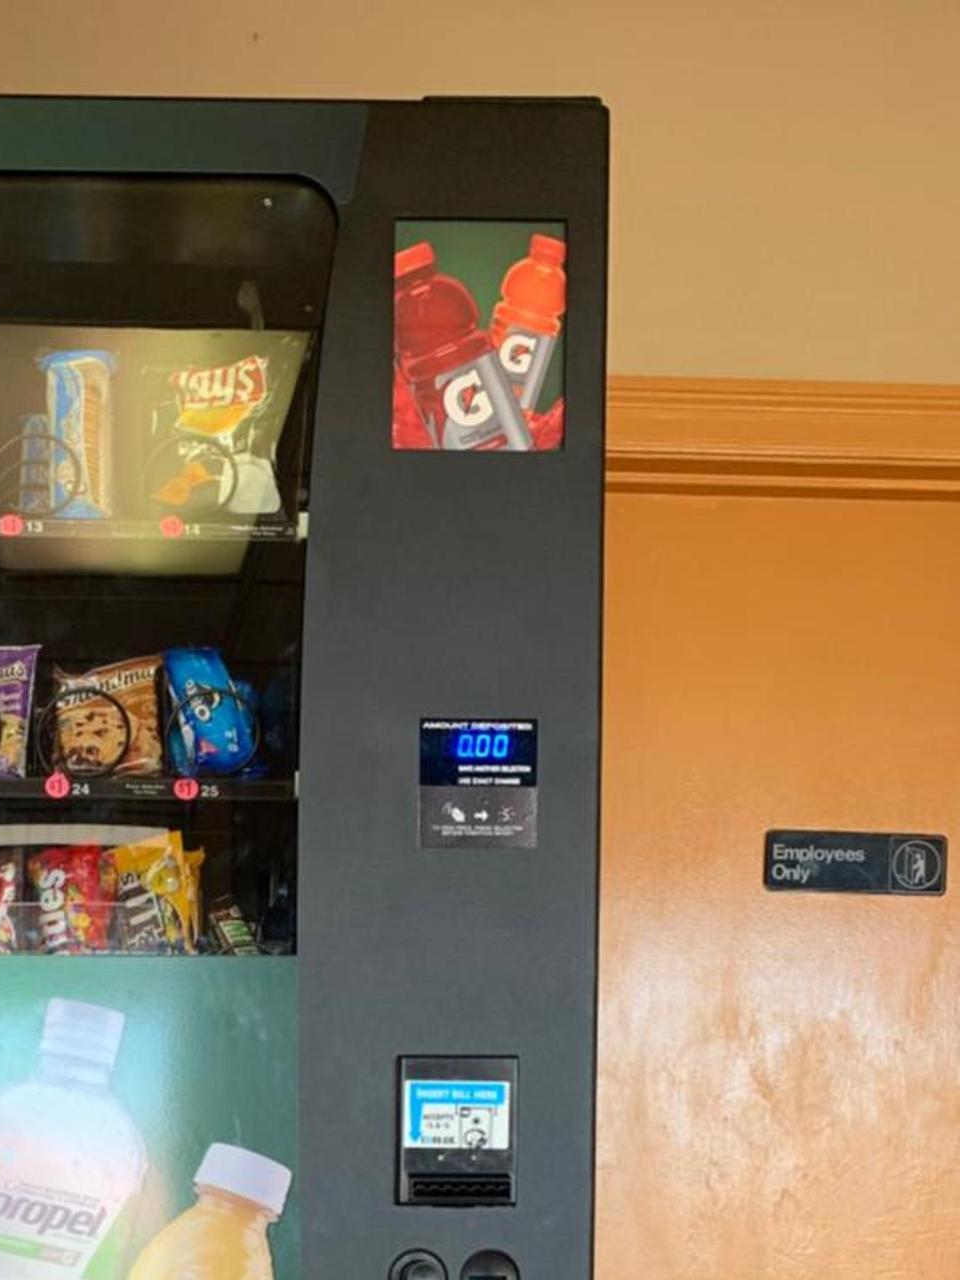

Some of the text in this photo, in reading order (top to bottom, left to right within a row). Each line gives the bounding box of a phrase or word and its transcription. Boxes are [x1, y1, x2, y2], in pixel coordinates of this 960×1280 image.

[499, 334, 538, 373] G
[443, 369, 494, 427] G
[457, 734, 509, 757] 0.00
[71, 783, 90, 796] 24
[200, 784, 220, 798] 25
[772, 843, 866, 864] Employees
[772, 863, 812, 884] Only
